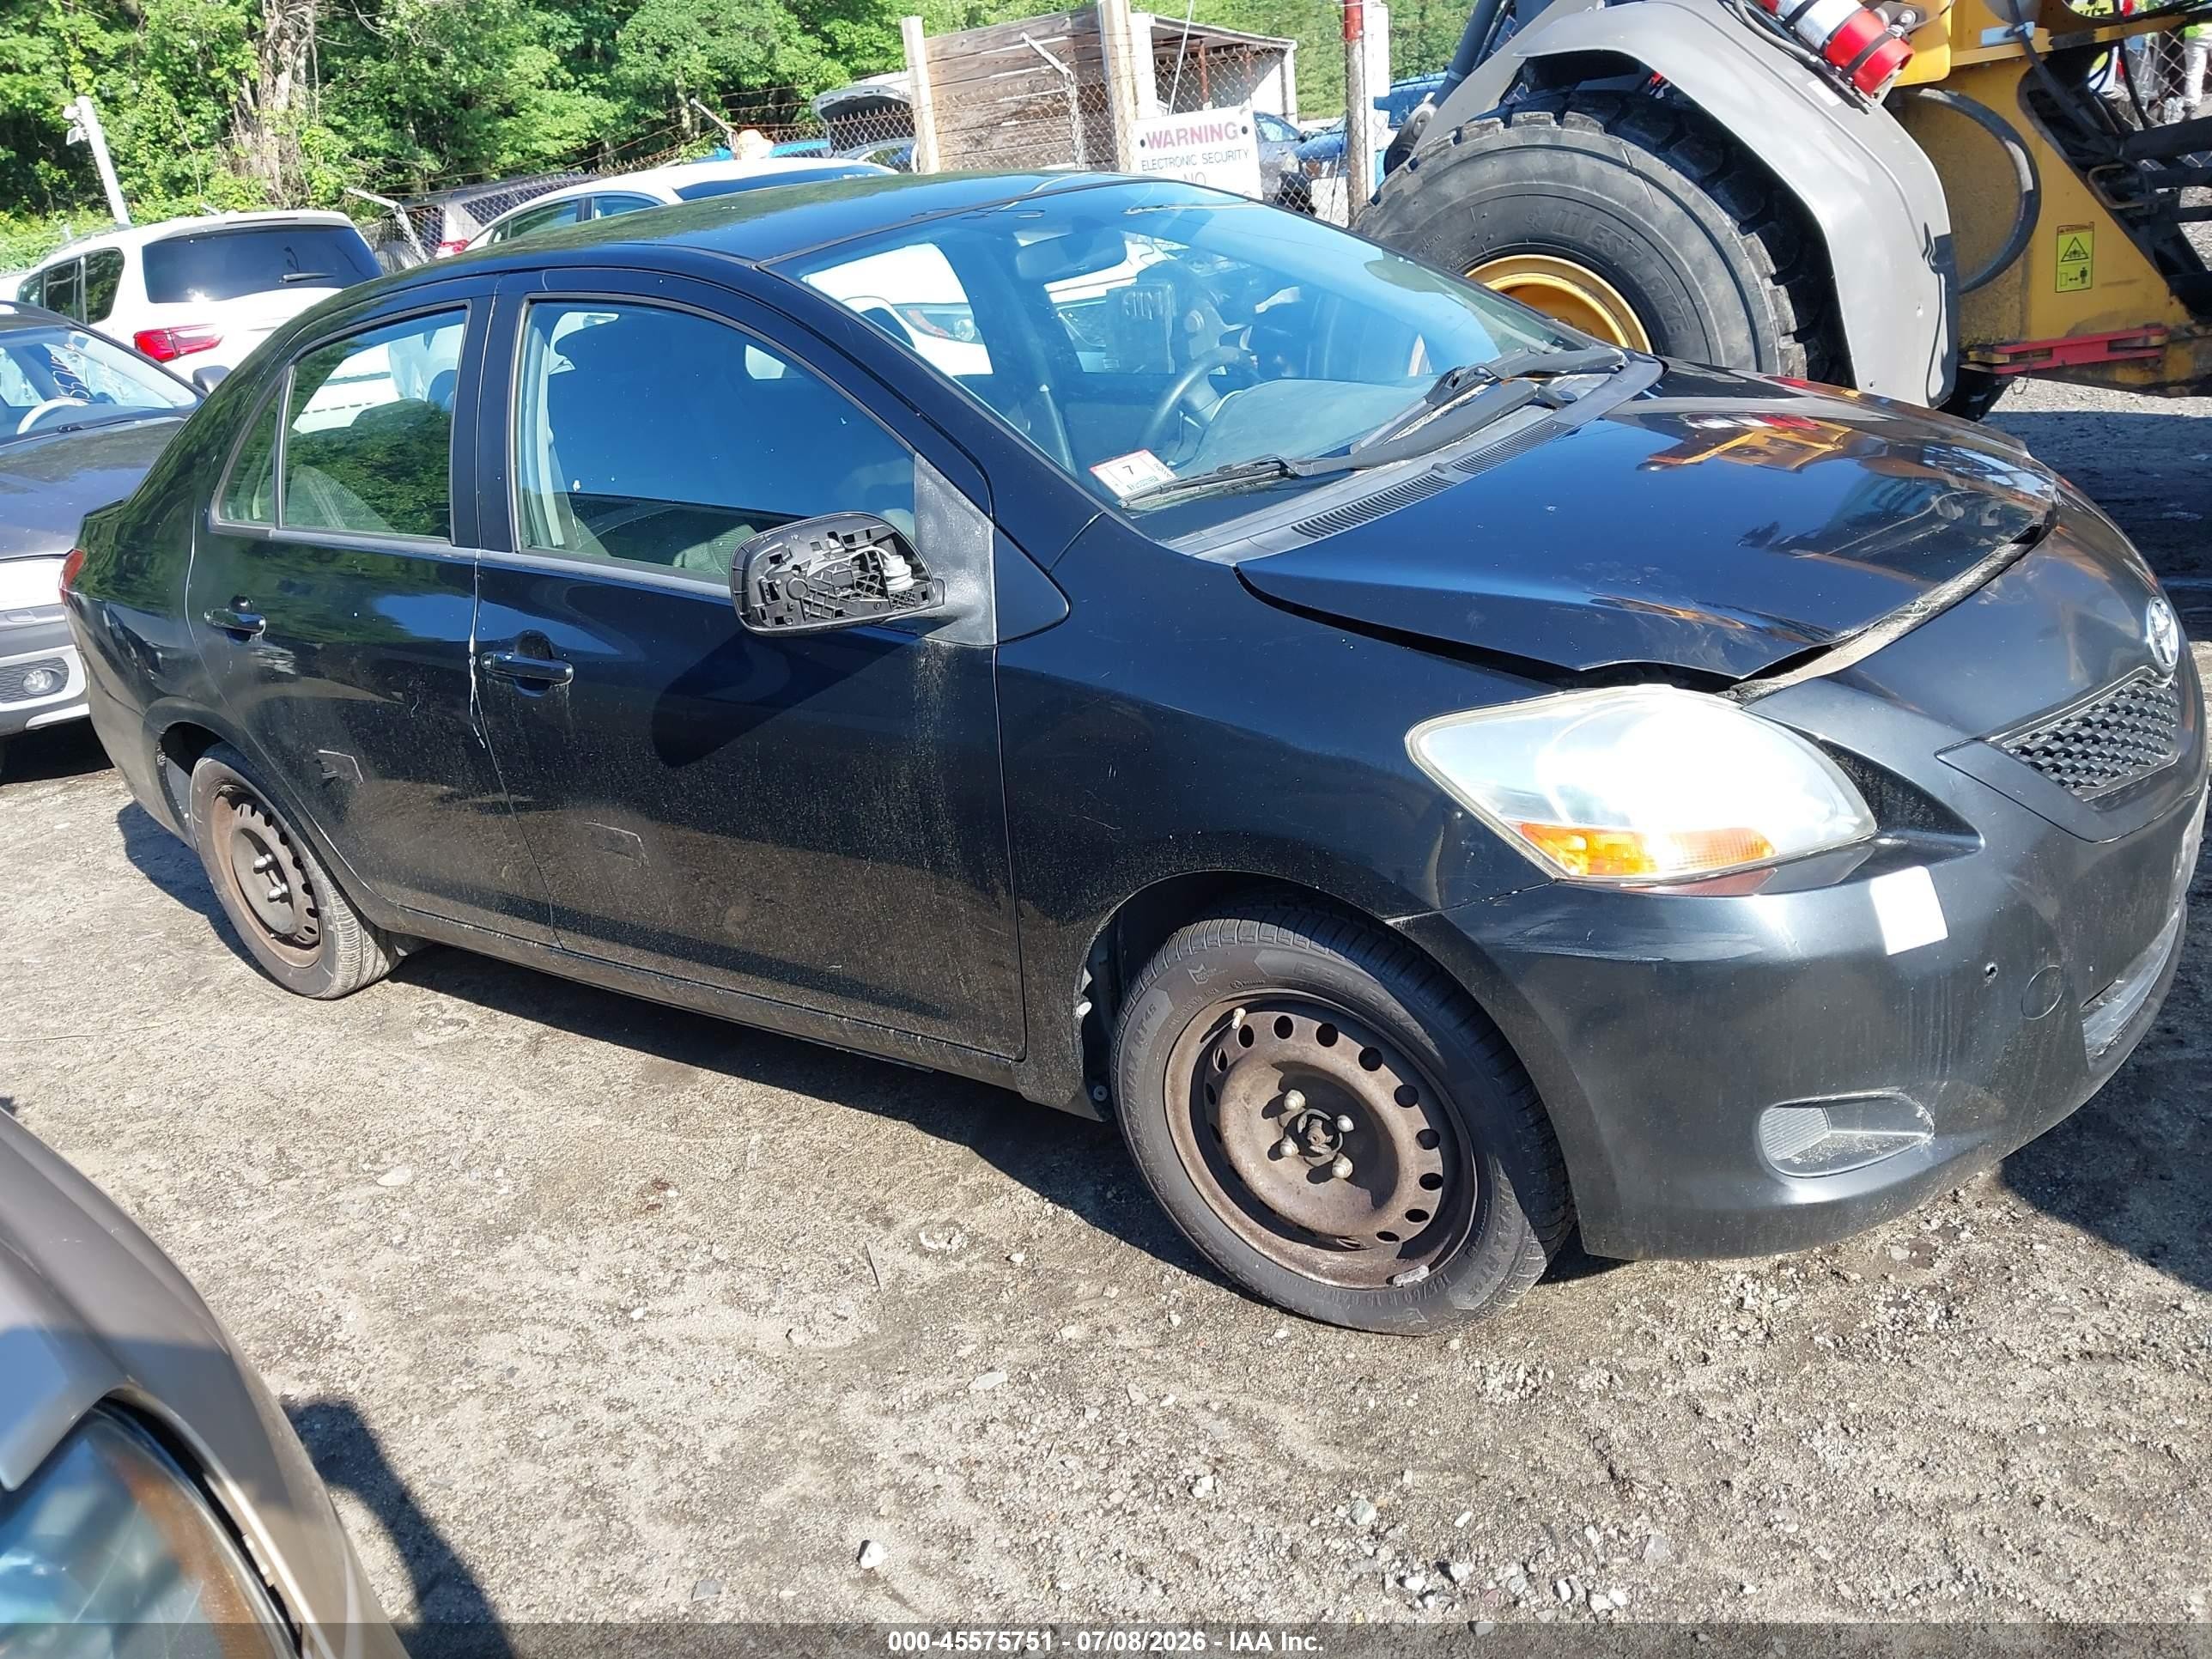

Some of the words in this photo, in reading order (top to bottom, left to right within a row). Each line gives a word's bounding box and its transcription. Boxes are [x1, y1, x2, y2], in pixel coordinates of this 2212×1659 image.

[1146, 121, 1239, 149] WARNING
[1141, 154, 1198, 172] ELECTRONIC
[1202, 149, 1249, 165] SECURITY
[1183, 172, 1206, 185] NO
[1122, 465, 1134, 475] 7
